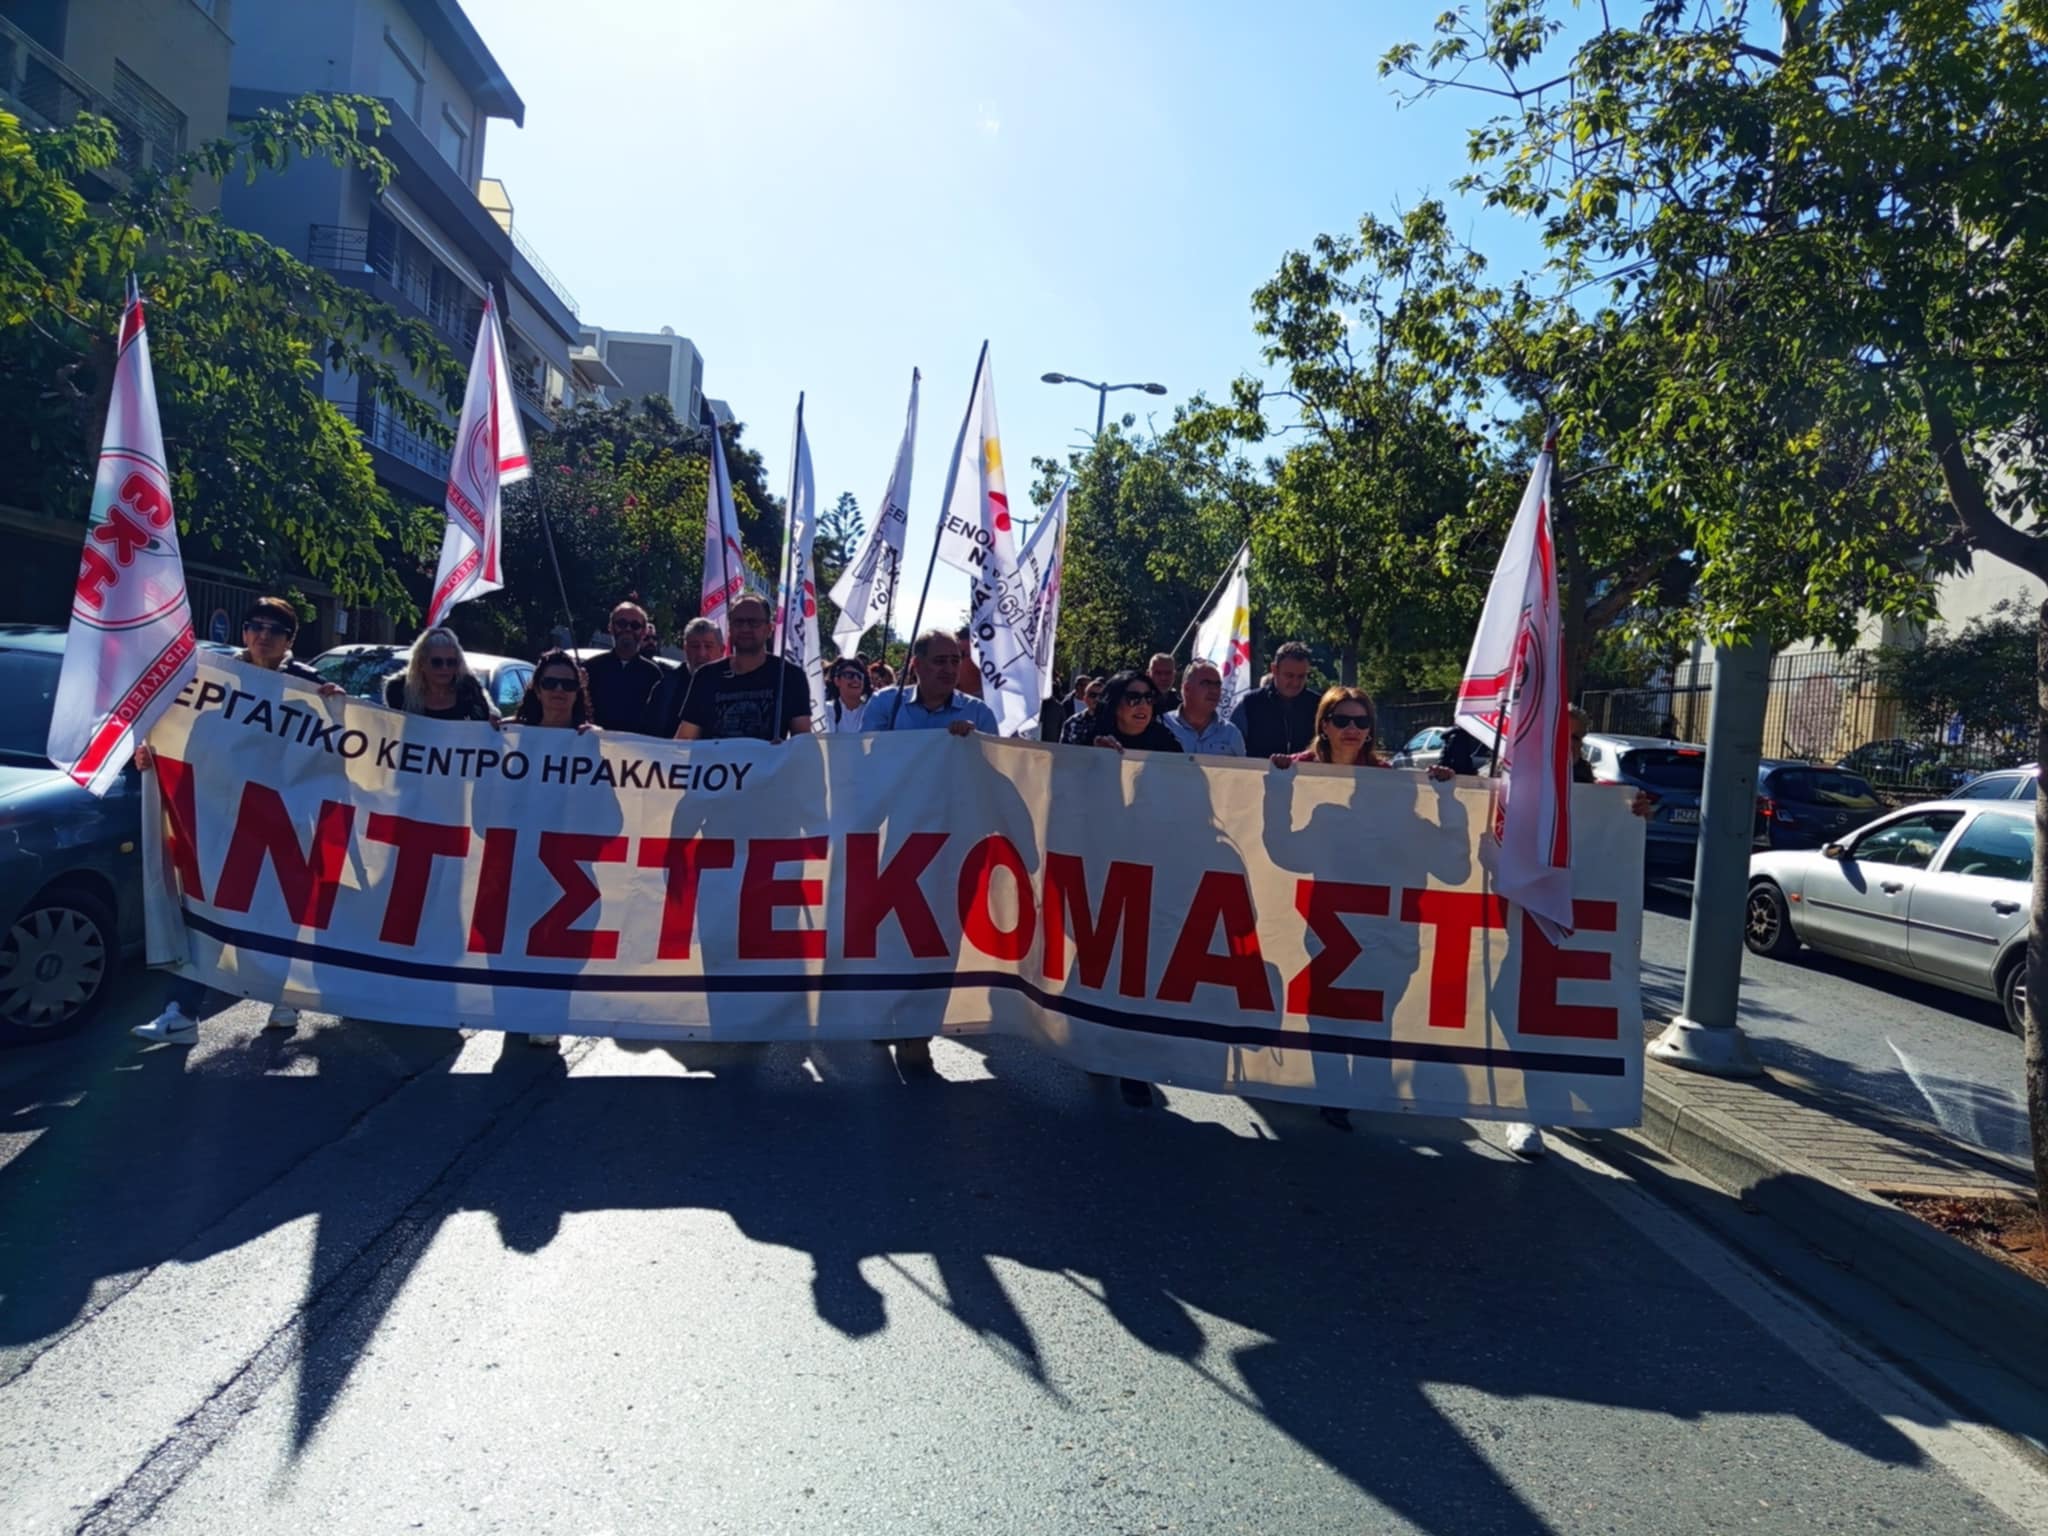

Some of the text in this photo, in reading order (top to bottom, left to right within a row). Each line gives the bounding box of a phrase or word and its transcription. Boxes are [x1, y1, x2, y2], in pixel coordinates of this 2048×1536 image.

[174, 678, 752, 792] ΕΡΓΑΤΙΚΟ ΚΕΝΤΡΟ ΗΡΑΚΛΕΙΟΥ
